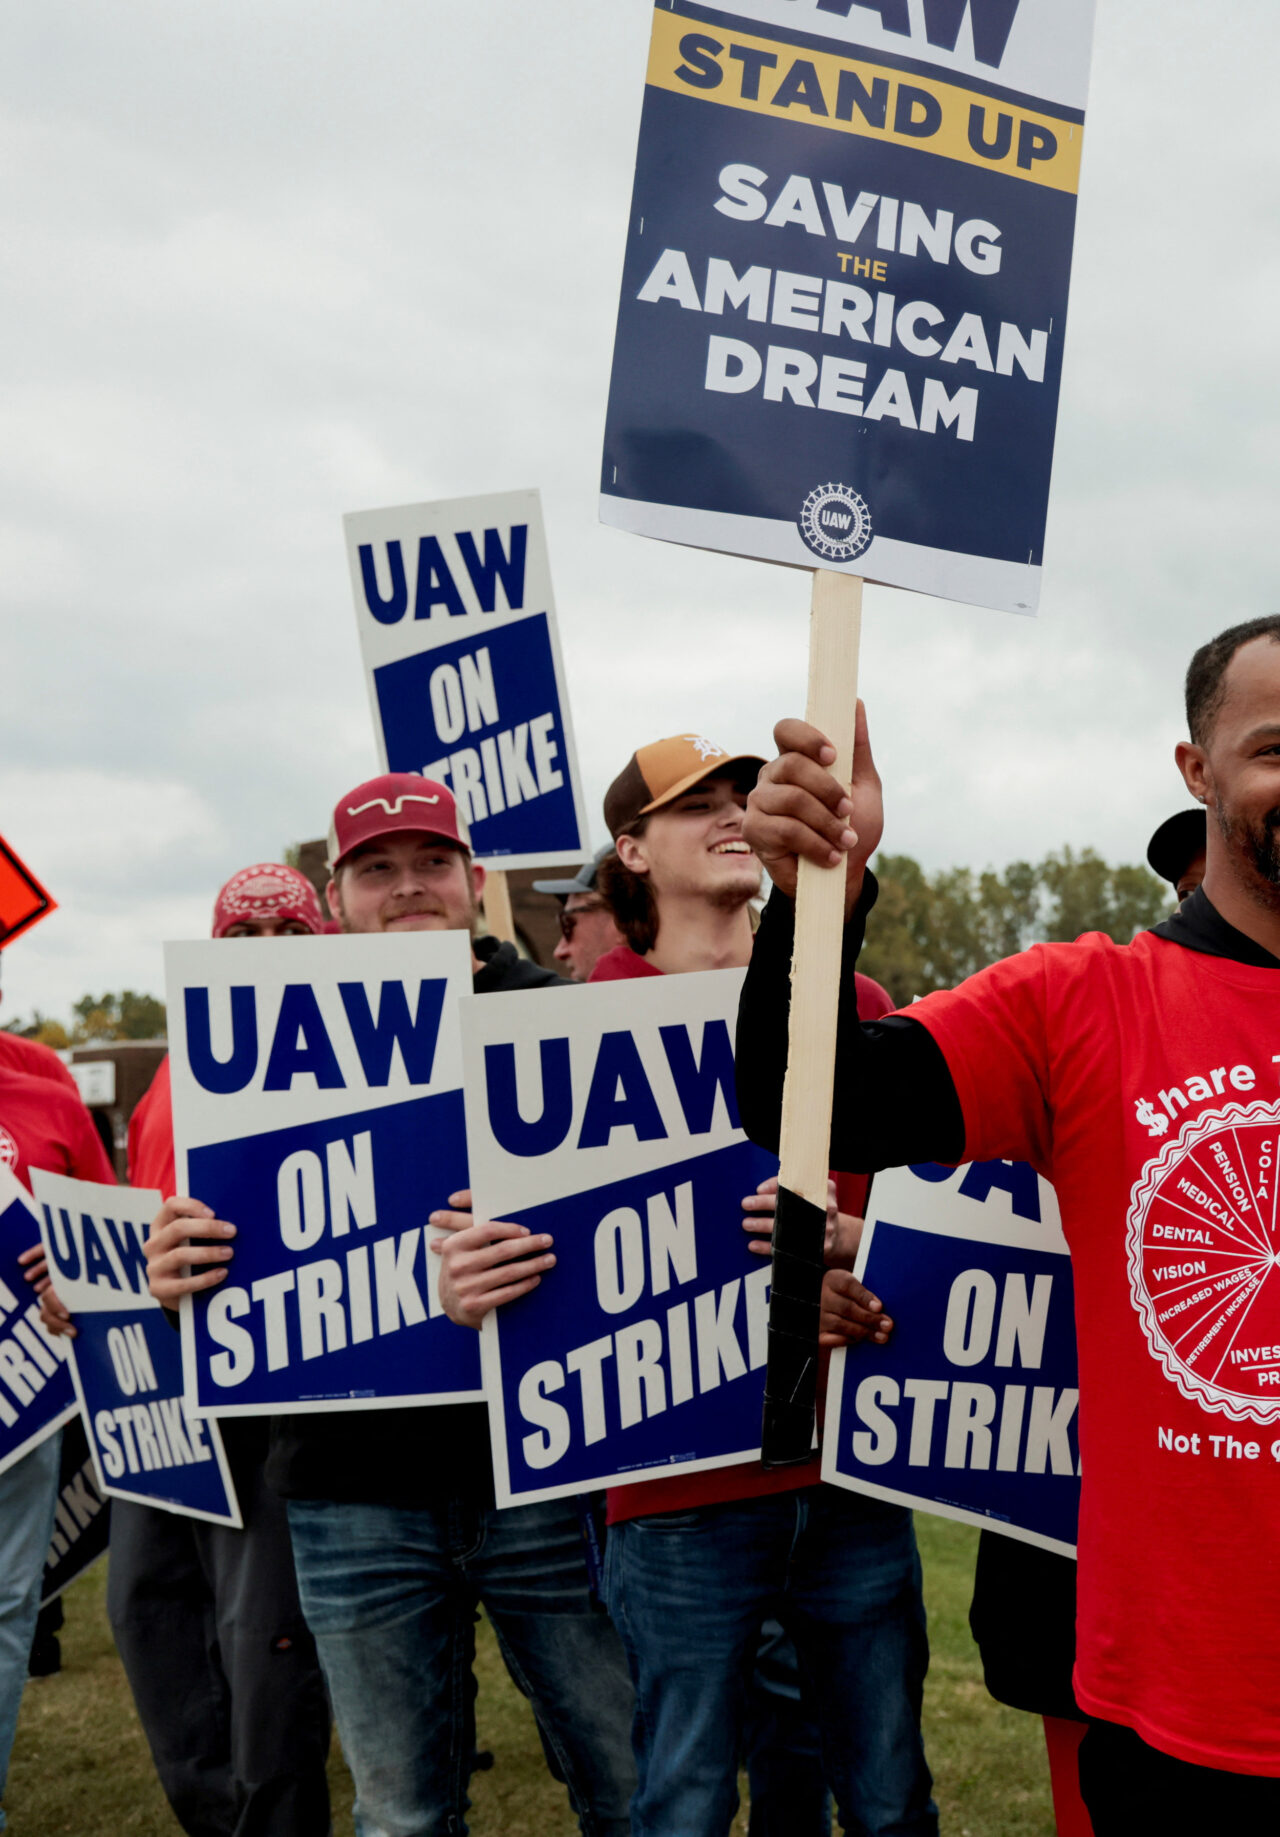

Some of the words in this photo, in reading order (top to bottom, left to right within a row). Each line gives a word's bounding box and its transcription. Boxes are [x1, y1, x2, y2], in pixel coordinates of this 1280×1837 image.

[673, 33, 943, 139] STAND
[967, 103, 1058, 171] UP
[713, 163, 1002, 276] SAVING
[836, 252, 888, 282] THE
[636, 248, 1048, 383] AMERICAN
[704, 334, 978, 442] DREAM
[821, 509, 852, 530] UAW
[358, 524, 528, 625] UAW
[429, 646, 499, 744] ON
[184, 978, 448, 1094] UAW
[1134, 1064, 1256, 1137] $hare
[277, 1130, 377, 1252] ON
[1177, 1177, 1236, 1231] MEDICAL
[1208, 1141, 1252, 1213] PENSION
[1256, 1140, 1272, 1200] COLA
[594, 1181, 697, 1314] ON
[1152, 1223, 1214, 1246] DENTAL
[1152, 1261, 1206, 1281] VISION
[943, 1269, 1053, 1369] ON
[1158, 1287, 1213, 1323] INCREASED
[1213, 1268, 1252, 1292] WAGES
[1186, 1315, 1227, 1366] RETIREMENT
[1225, 1277, 1260, 1317] INCREASE
[107, 1323, 158, 1396] ON
[96, 1396, 212, 1478] STRIKE
[852, 1375, 1082, 1476] STRIK
[1158, 1426, 1200, 1455] Not
[1208, 1435, 1261, 1460] The
